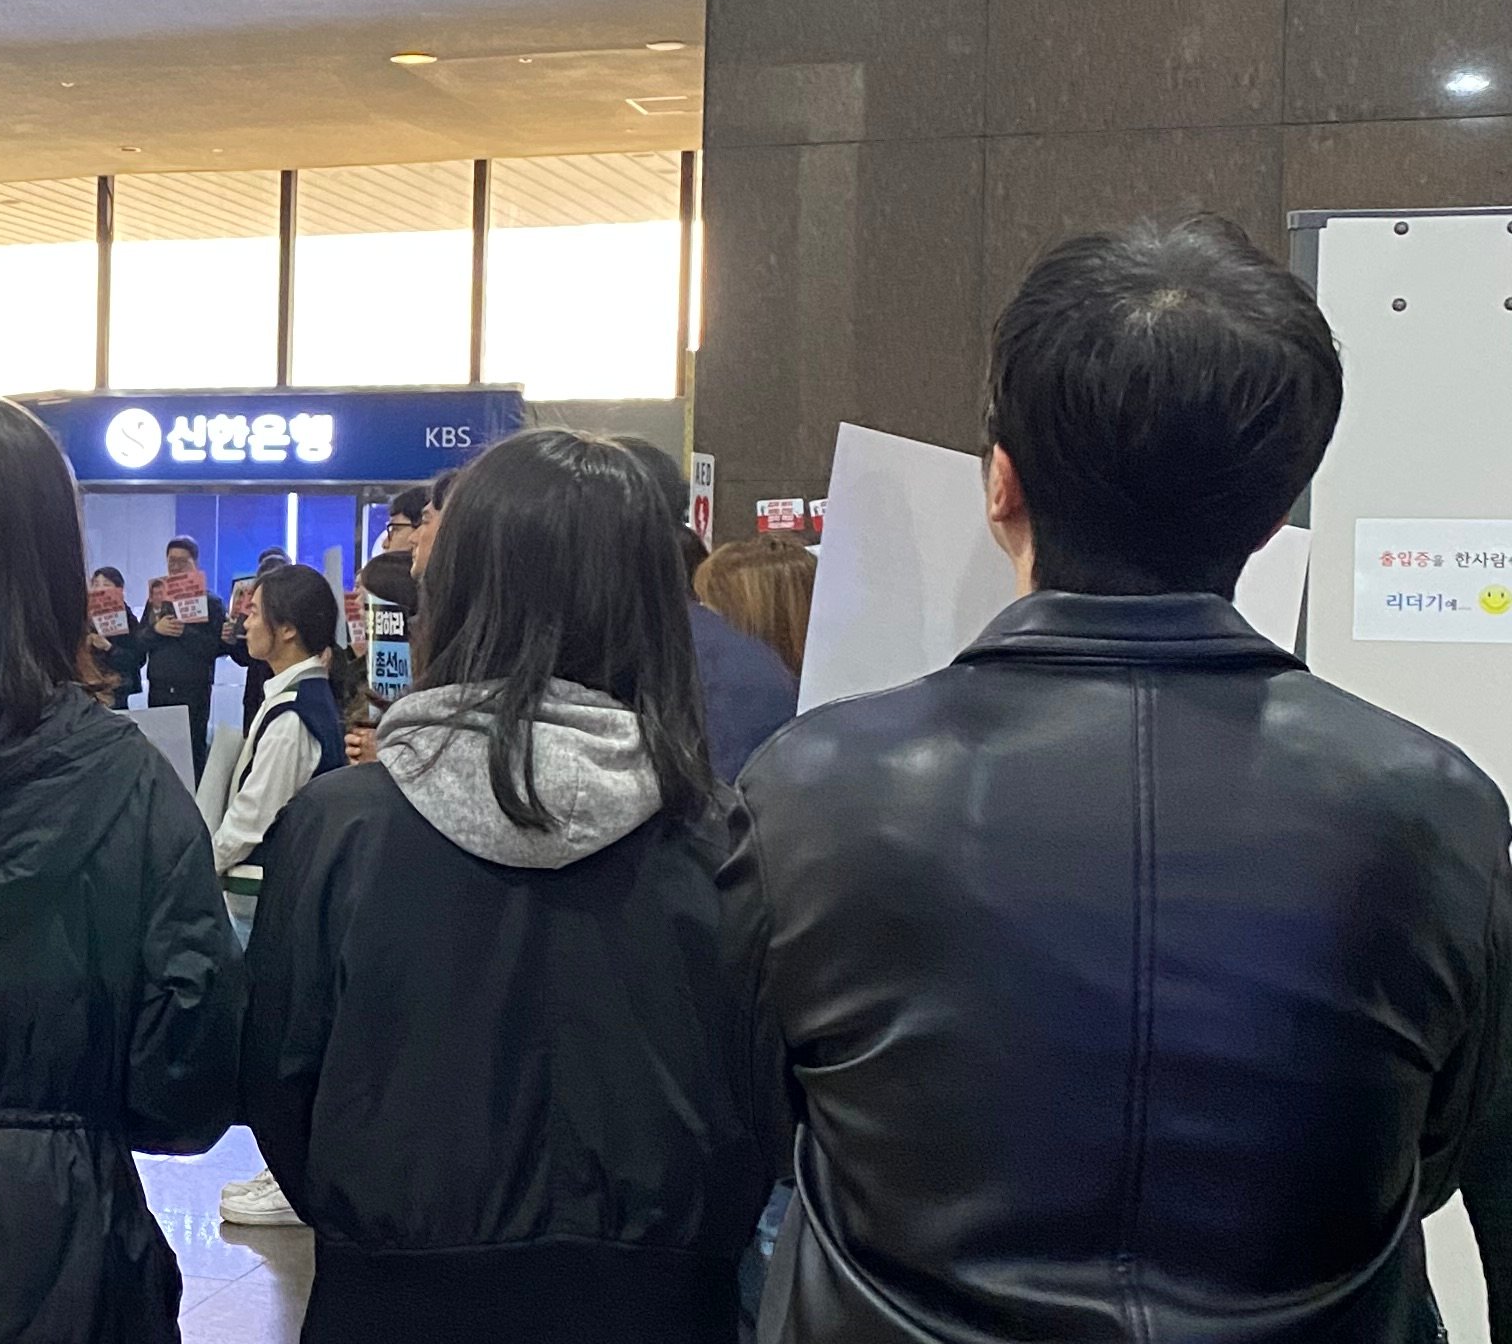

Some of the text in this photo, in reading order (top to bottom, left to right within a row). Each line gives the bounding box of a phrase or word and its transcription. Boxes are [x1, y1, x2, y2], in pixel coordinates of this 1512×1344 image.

[167, 413, 334, 462] 신한은행
[425, 426, 472, 449] KBS
[696, 462, 712, 486] AED
[1379, 551, 1512, 569] 출입증을 한사람
[375, 611, 405, 636] 답하라
